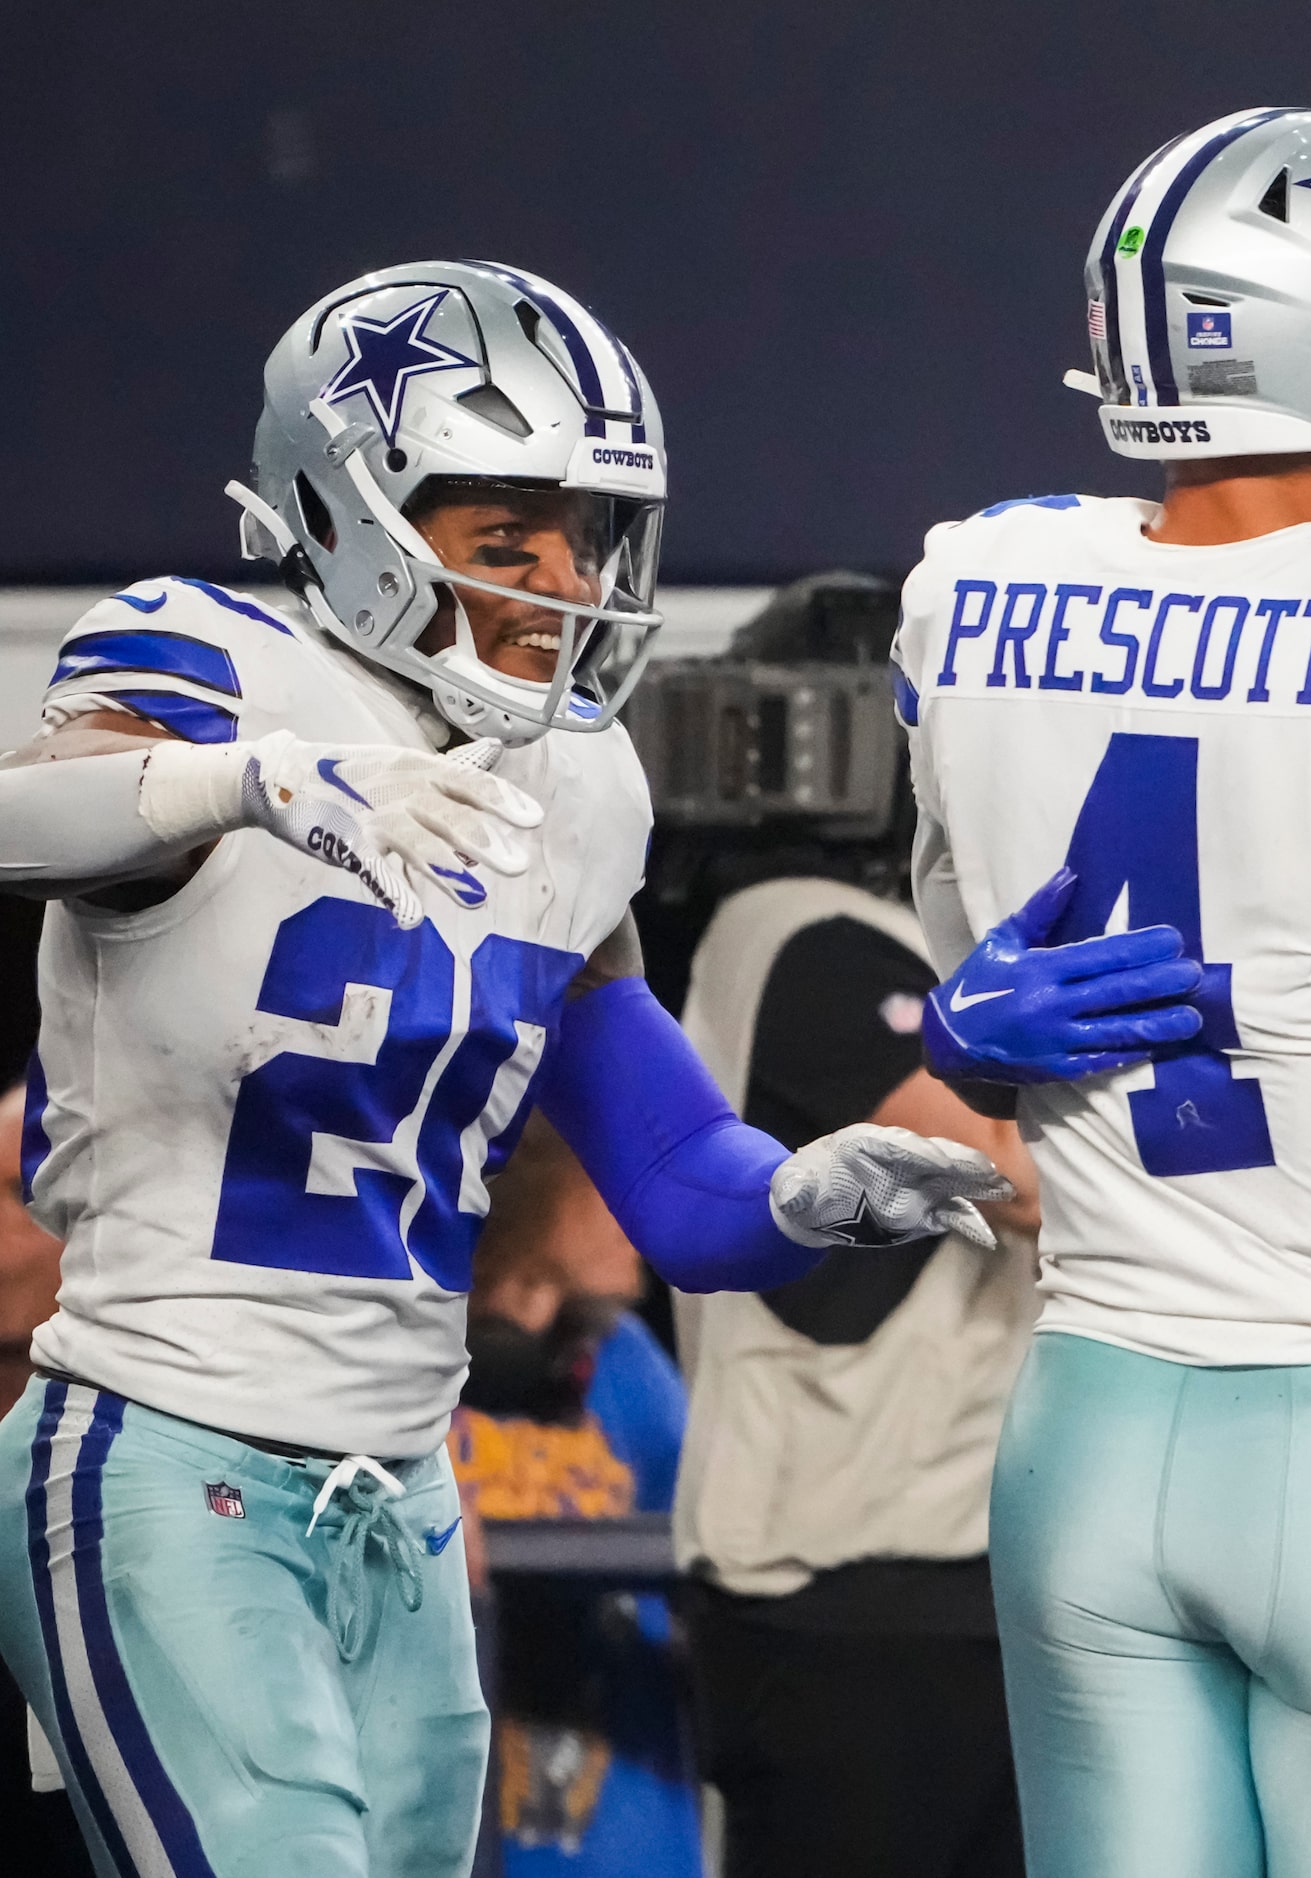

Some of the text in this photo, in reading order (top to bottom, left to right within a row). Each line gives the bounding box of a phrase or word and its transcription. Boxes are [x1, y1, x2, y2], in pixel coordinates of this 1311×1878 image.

[1110, 419, 1211, 443] COWBOYS
[593, 448, 654, 470] COWBOYS
[1043, 732, 1276, 1177] 4
[211, 895, 586, 1293] 20
[213, 1497, 243, 1516] NFL
